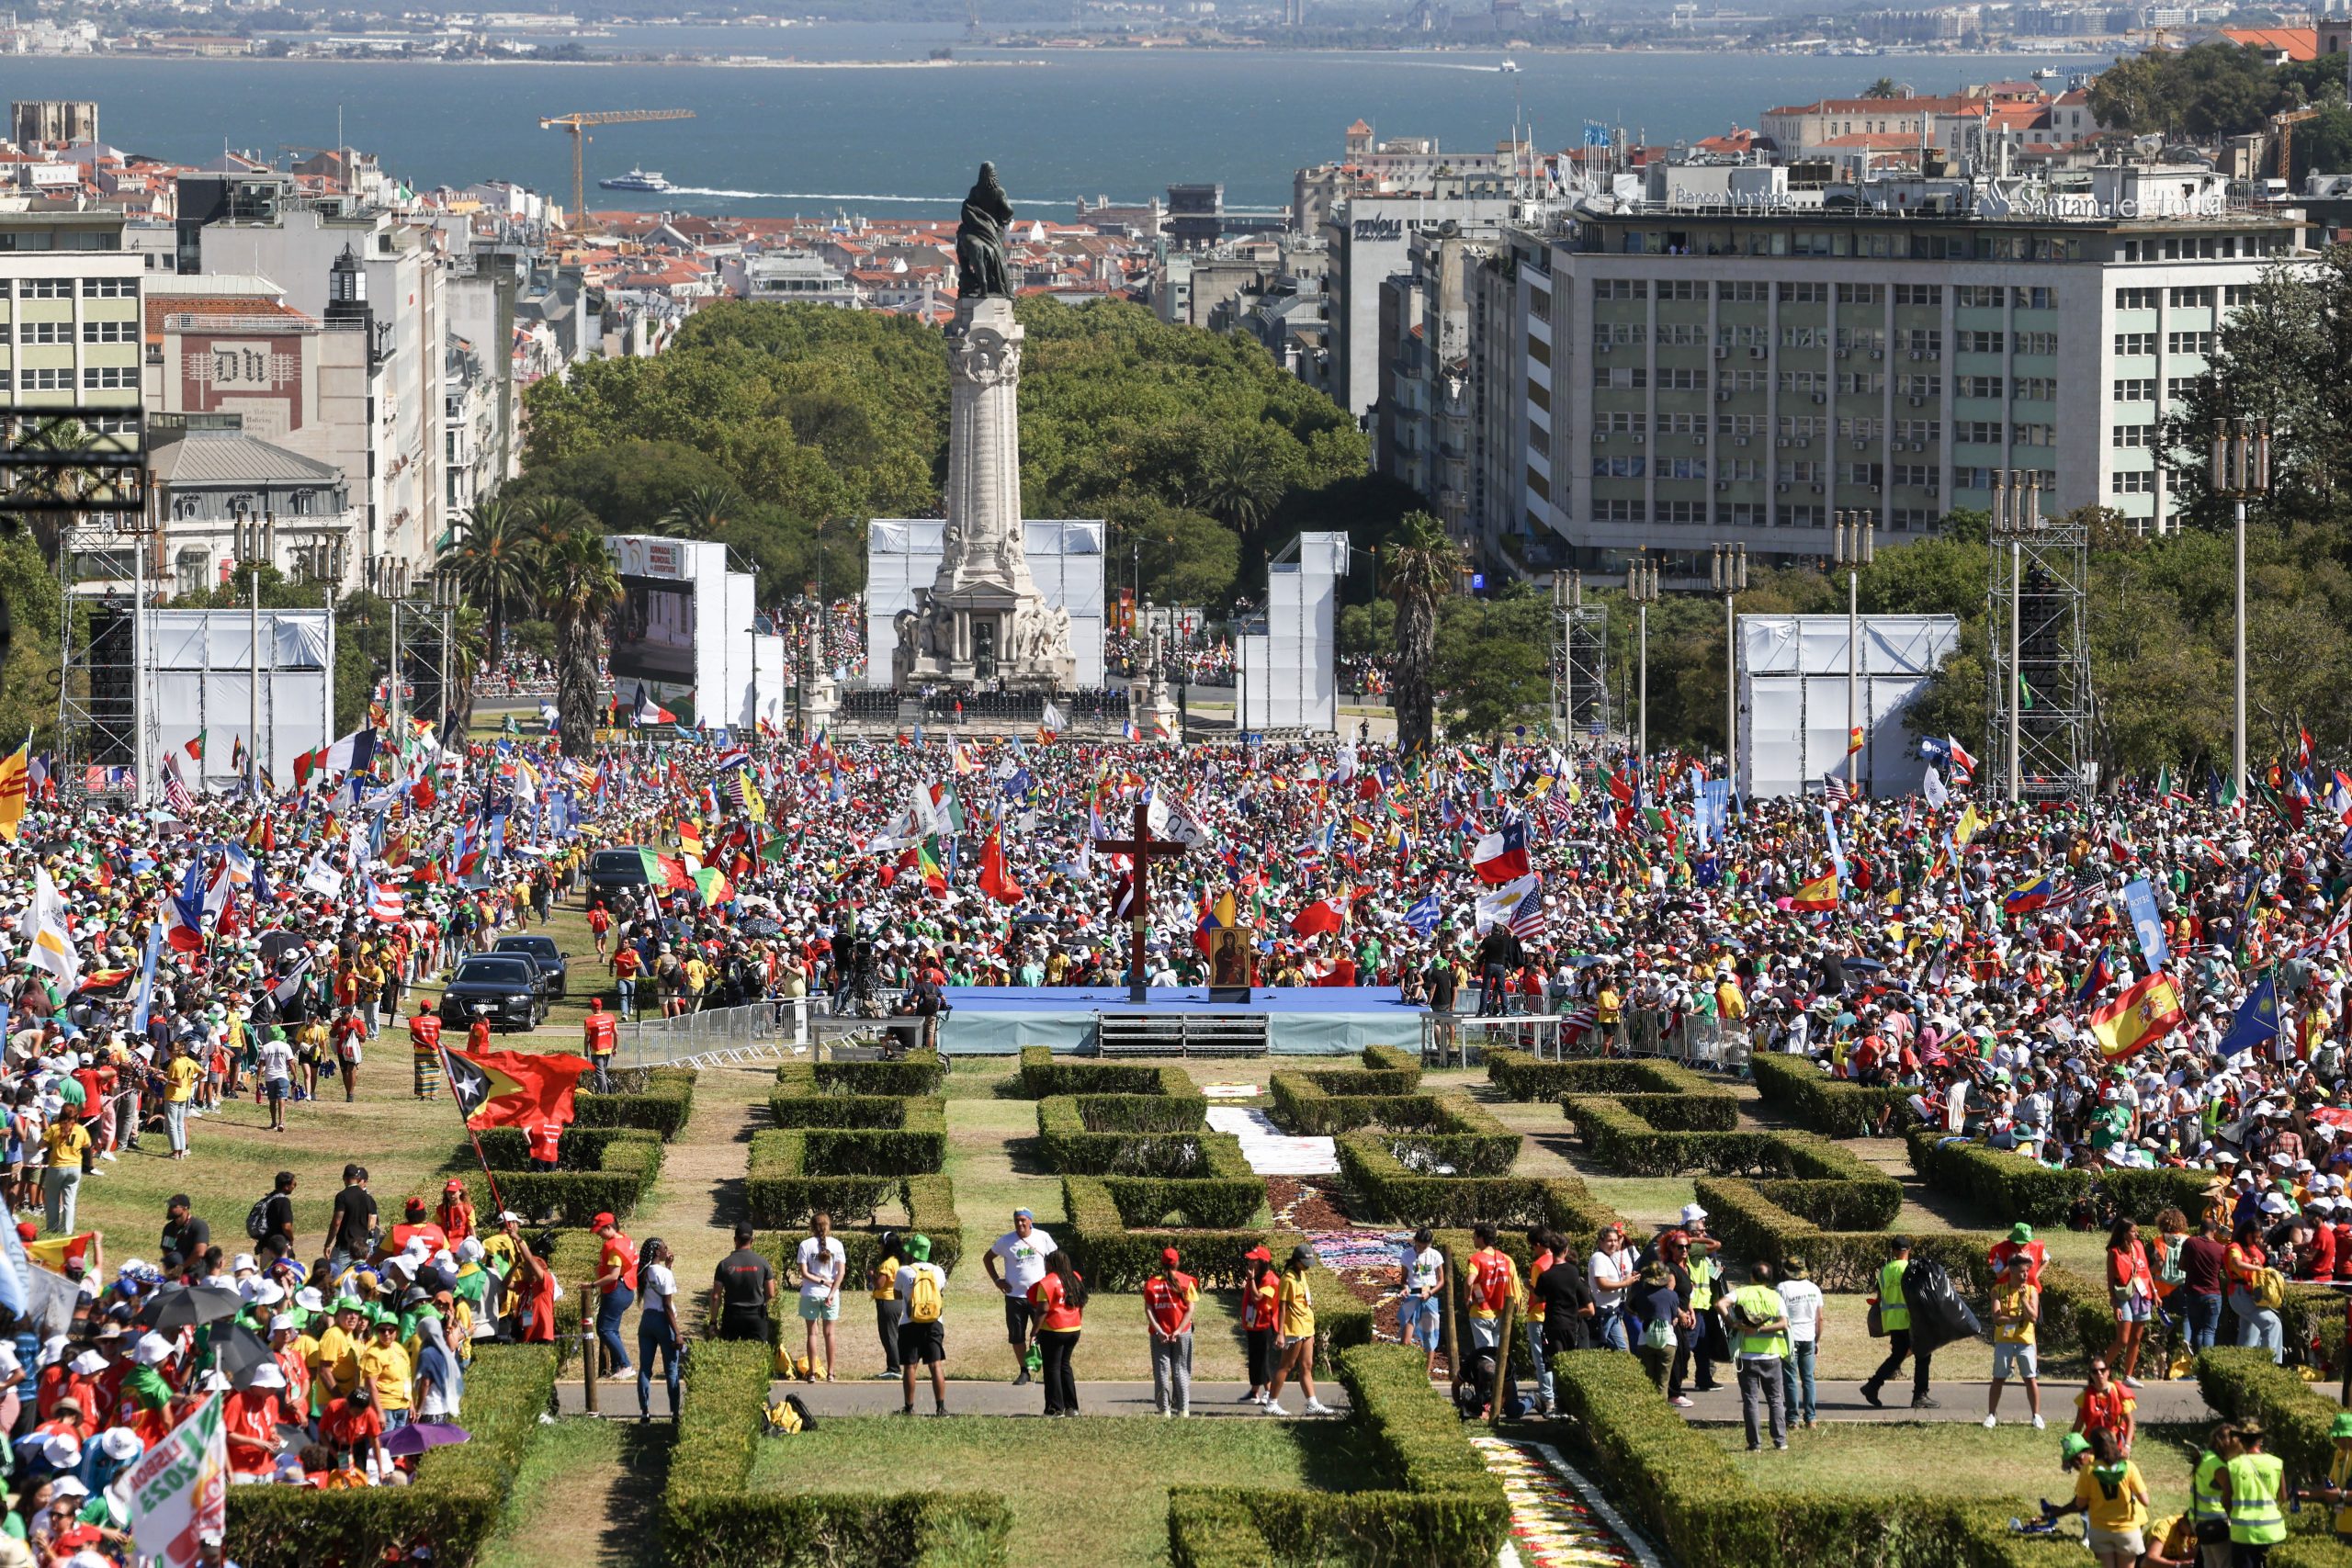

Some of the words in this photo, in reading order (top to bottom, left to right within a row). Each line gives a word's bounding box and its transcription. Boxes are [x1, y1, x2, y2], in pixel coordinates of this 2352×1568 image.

[1676, 186, 1722, 204] Banco
[2019, 186, 2145, 217] Santander
[2152, 187, 2224, 218] Totta
[1352, 212, 1402, 235] TIVOLI
[1474, 575, 1481, 585] P
[717, 734, 724, 744] P
